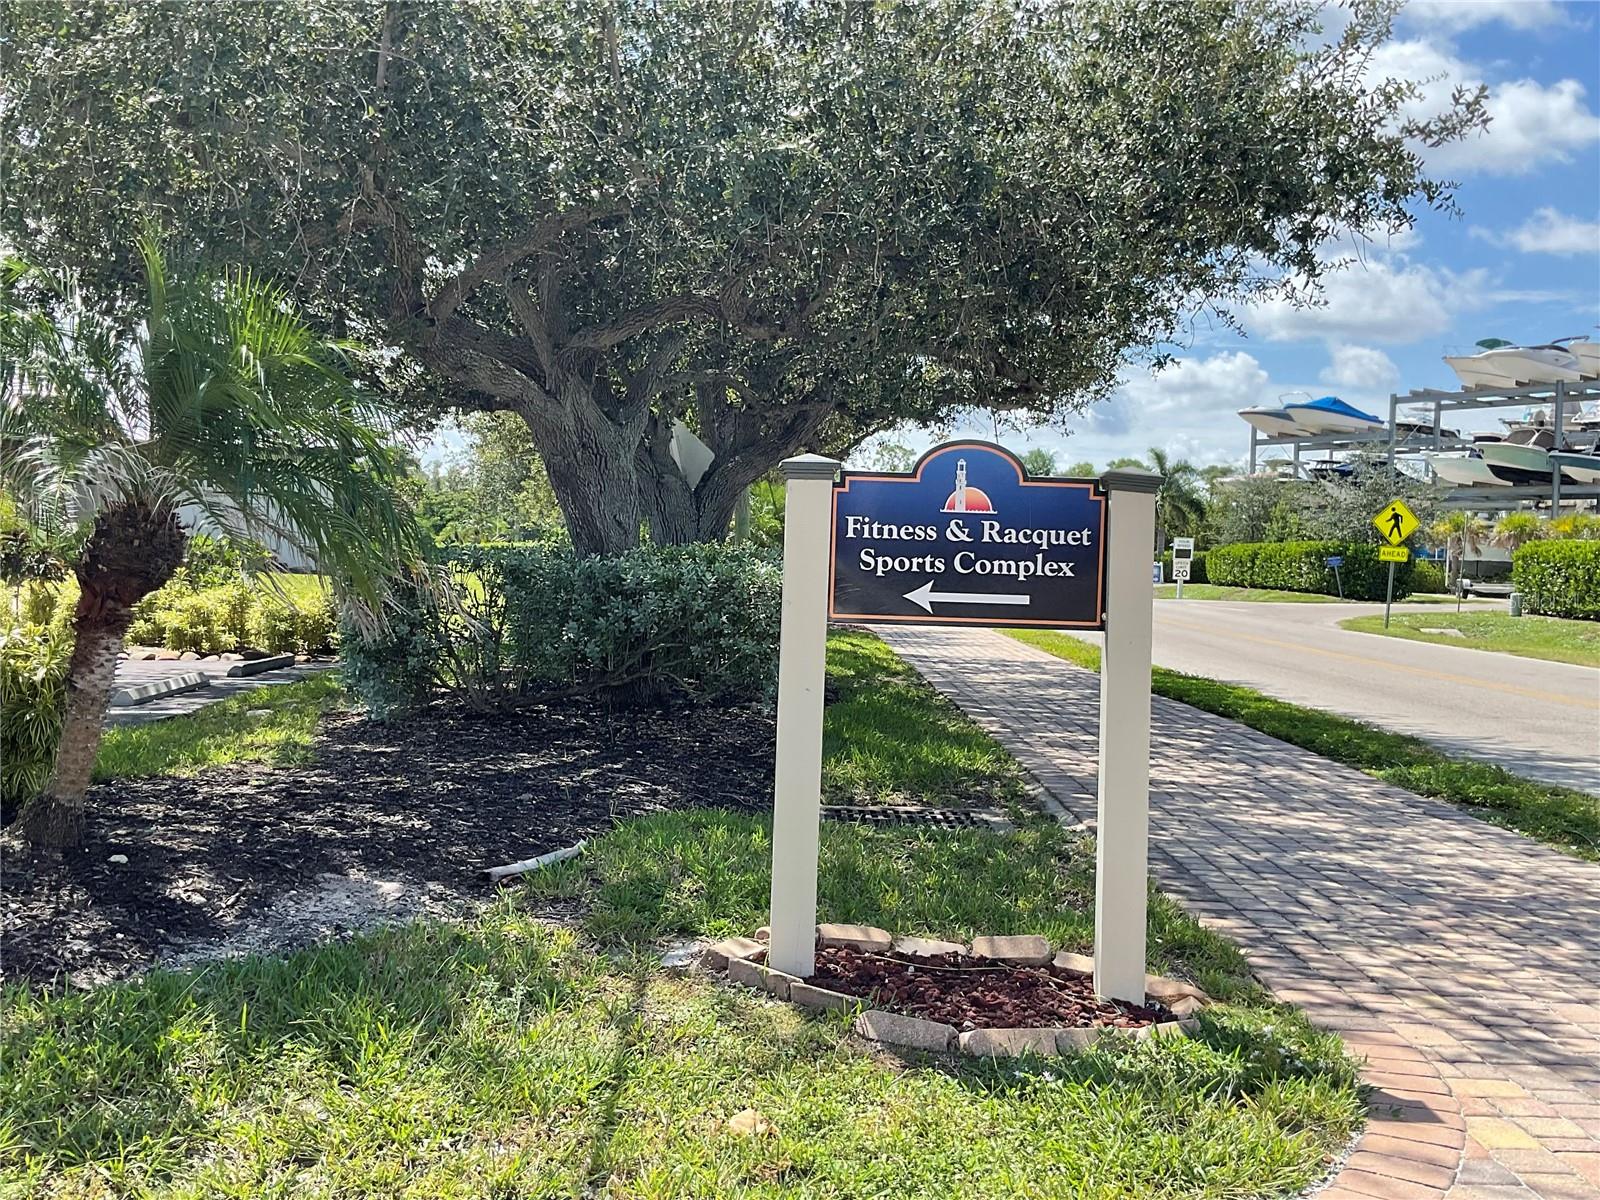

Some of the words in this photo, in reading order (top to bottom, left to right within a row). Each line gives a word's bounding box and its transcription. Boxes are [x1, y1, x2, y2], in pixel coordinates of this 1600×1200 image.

[845, 515, 937, 541] Fitness
[945, 519, 974, 542] &
[981, 520, 1092, 550] Racquet
[859, 548, 945, 577] Sports
[953, 551, 1075, 581] Complex
[1382, 550, 1406, 559] AHEAD
